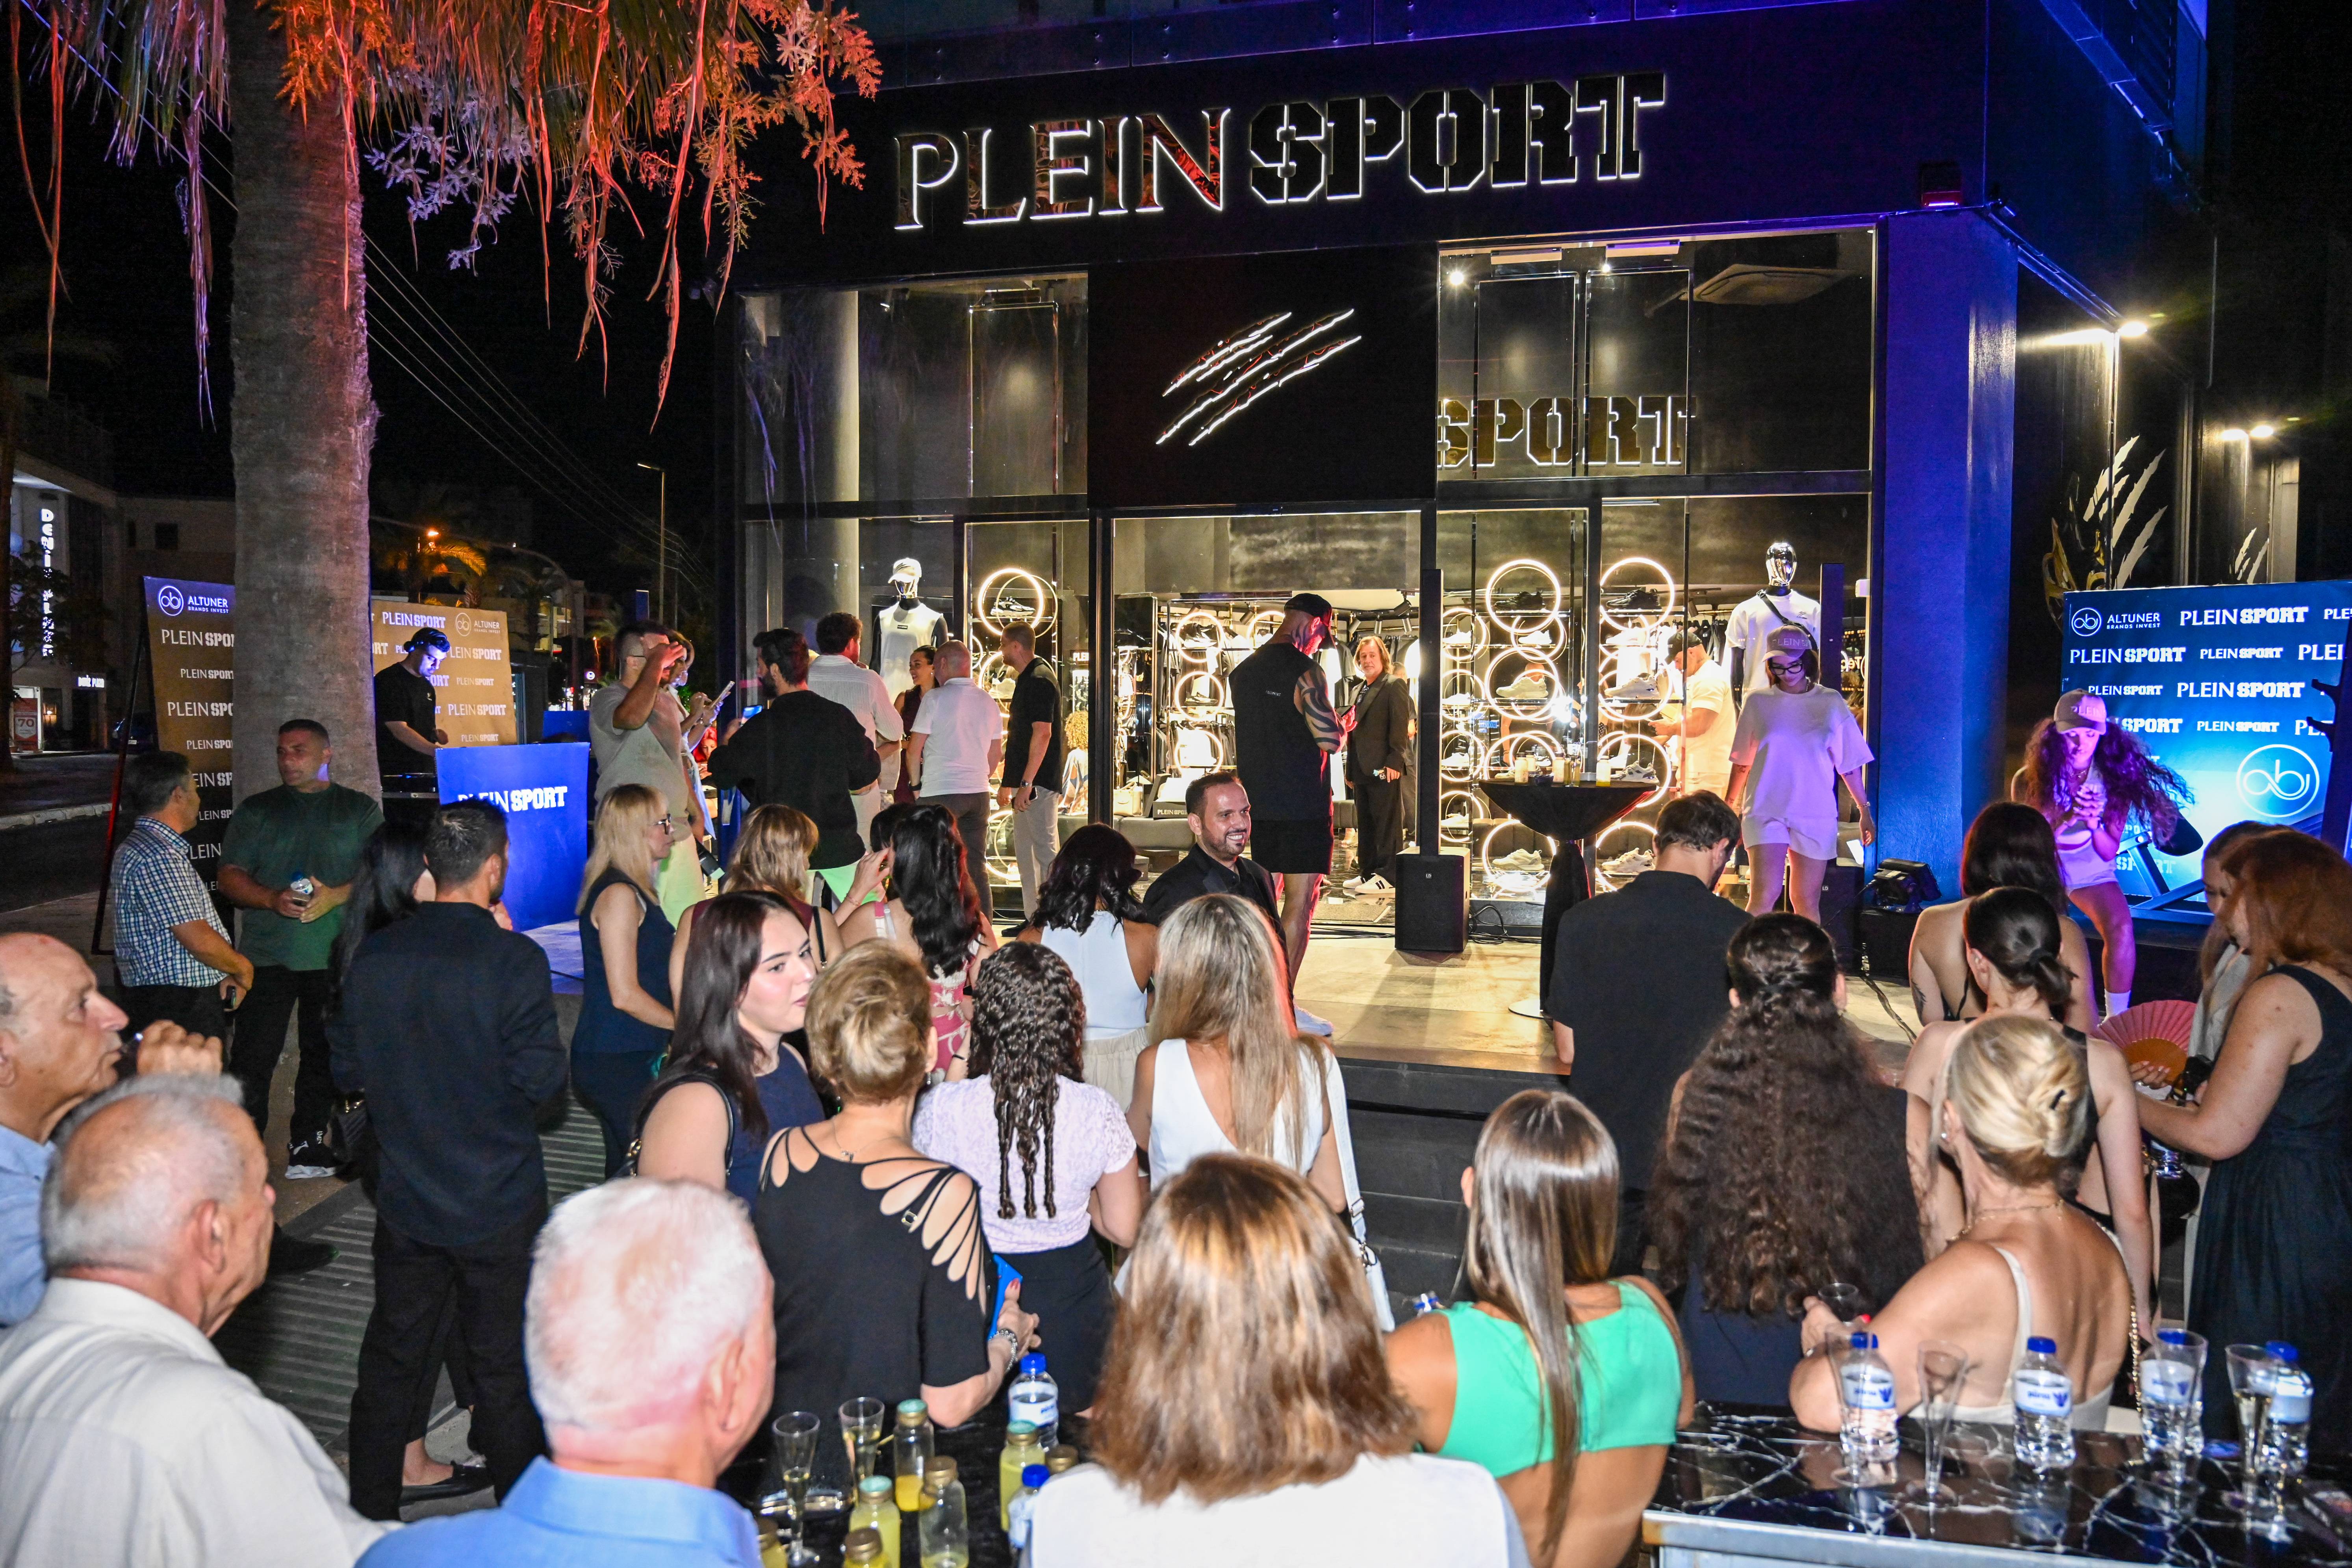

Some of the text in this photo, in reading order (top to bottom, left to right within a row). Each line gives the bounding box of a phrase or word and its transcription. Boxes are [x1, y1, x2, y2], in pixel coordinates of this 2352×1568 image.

[894, 73, 1665, 230] PLEIN SPORT
[188, 596, 228, 608] ALTUNER
[382, 611, 413, 626] PLEIN
[414, 614, 446, 629] SPORT
[2107, 613, 2160, 623] ALTUNER
[2180, 606, 2308, 626] PLEIN SPORT
[2324, 608, 2352, 620] PLE
[474, 620, 500, 629] ALTUNER
[161, 629, 234, 647] PLEIN SPO
[450, 646, 502, 660] LEIN SPORT
[2070, 647, 2186, 663] PLEIN SPORT
[2200, 647, 2283, 659] PLEIN SPORT
[2298, 644, 2343, 660] PLEI
[180, 669, 207, 679] PLEIN
[426, 675, 449, 687] ORT
[456, 677, 475, 685] PLEIN
[2088, 685, 2163, 695] PLEIN SPORT
[2177, 682, 2305, 698] PLEIN SPORT
[167, 702, 208, 716] PLEIN
[448, 704, 477, 716] PLEIN
[477, 704, 506, 716] SPORT
[2122, 718, 2183, 733] SPORT
[2197, 721, 2280, 732] PLEIN SPORT
[187, 740, 233, 750] PLEIN SPO
[511, 786, 568, 811] SPORT
[199, 810, 219, 820] LEIN
[190, 843, 221, 859] LEIN
